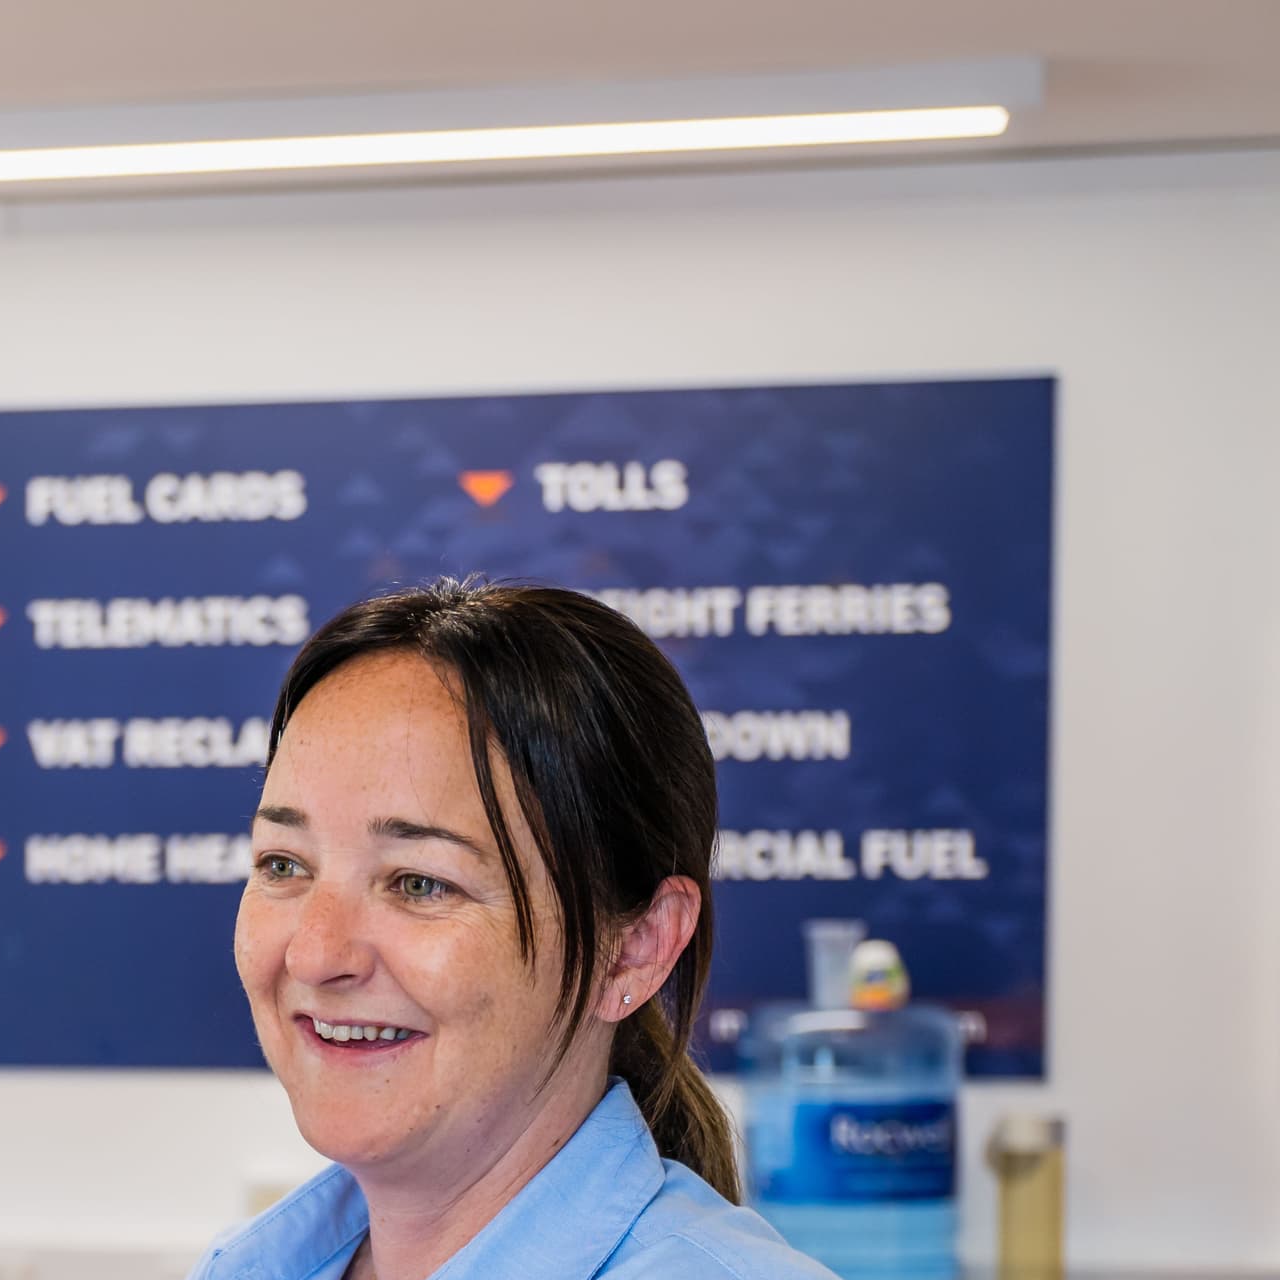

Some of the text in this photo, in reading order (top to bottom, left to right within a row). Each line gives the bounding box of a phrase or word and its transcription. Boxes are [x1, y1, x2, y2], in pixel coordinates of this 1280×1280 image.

[26, 469, 308, 526] FUEL CARDS
[534, 459, 688, 513] TOLLS
[27, 596, 309, 649] TELEMATICS
[746, 582, 951, 637] FERRIES
[27, 716, 268, 768] VAT RECLA
[702, 711, 851, 760] DOWN
[25, 833, 252, 884] HOME HEA
[712, 829, 987, 879] RCIAL FUEL
